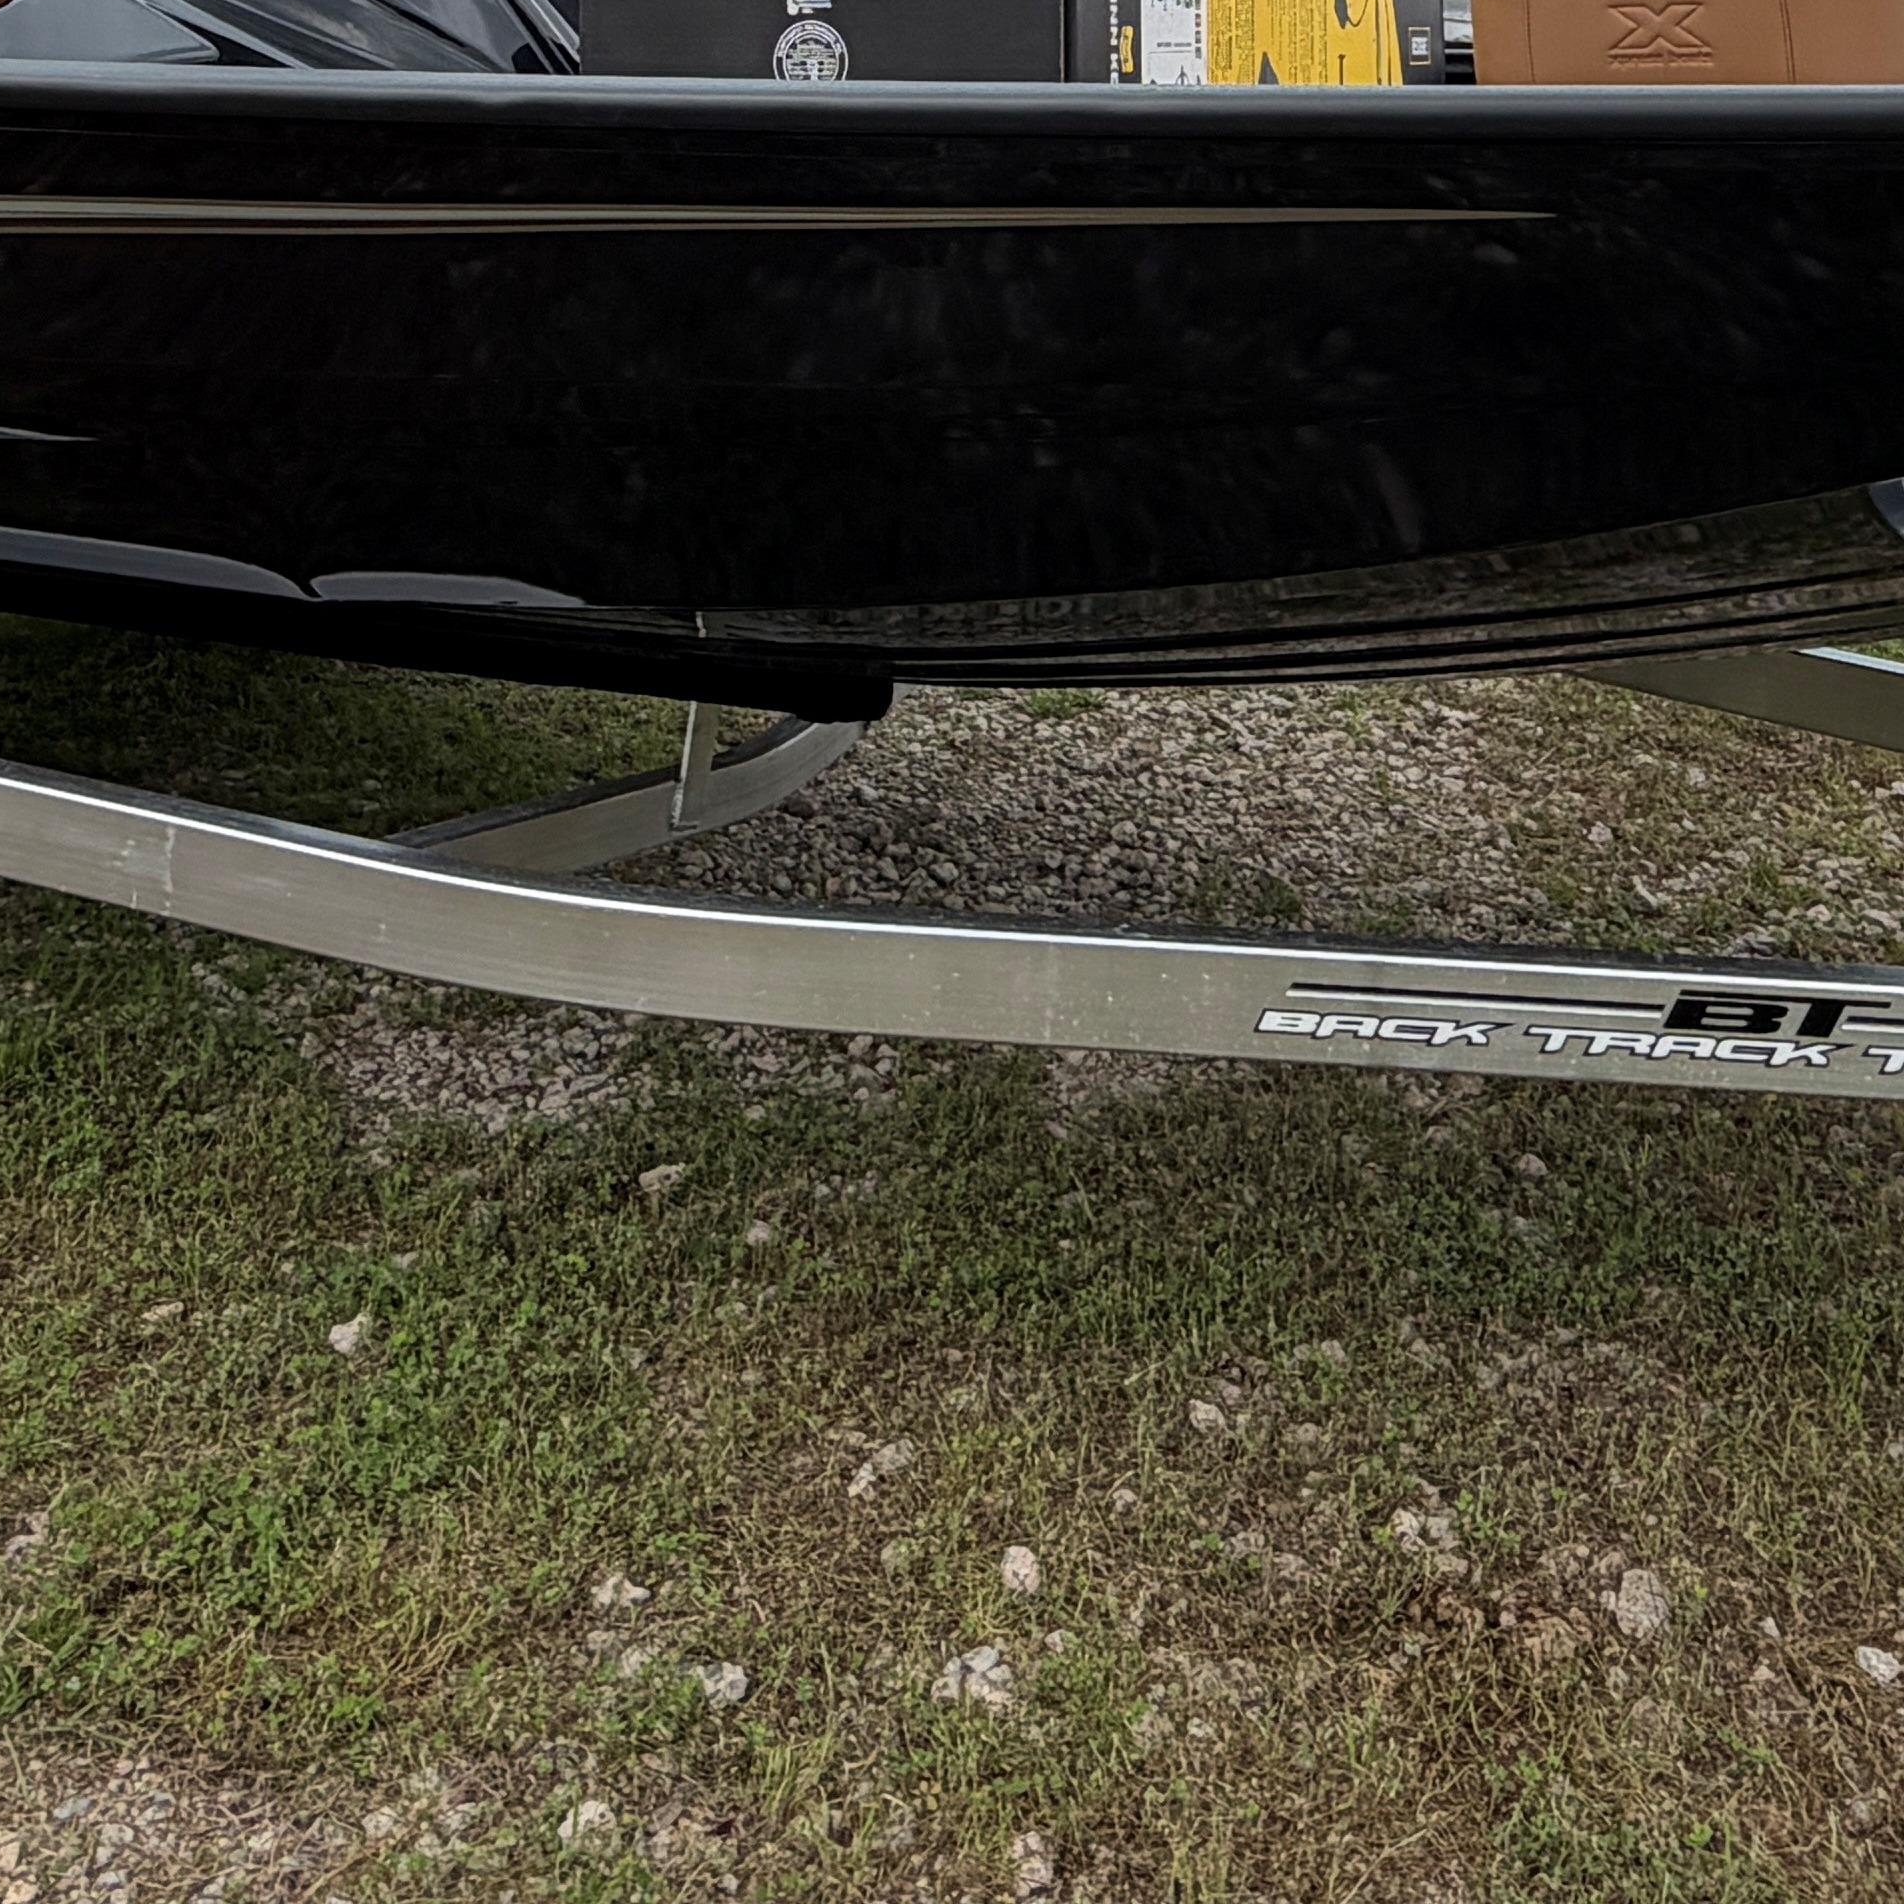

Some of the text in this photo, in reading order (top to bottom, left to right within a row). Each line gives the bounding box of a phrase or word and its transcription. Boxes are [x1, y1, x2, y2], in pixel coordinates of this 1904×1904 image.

[1254, 1007, 1510, 1047] BACK
[1523, 1024, 1850, 1069] TRACK
[1664, 989, 1892, 1038] BT
